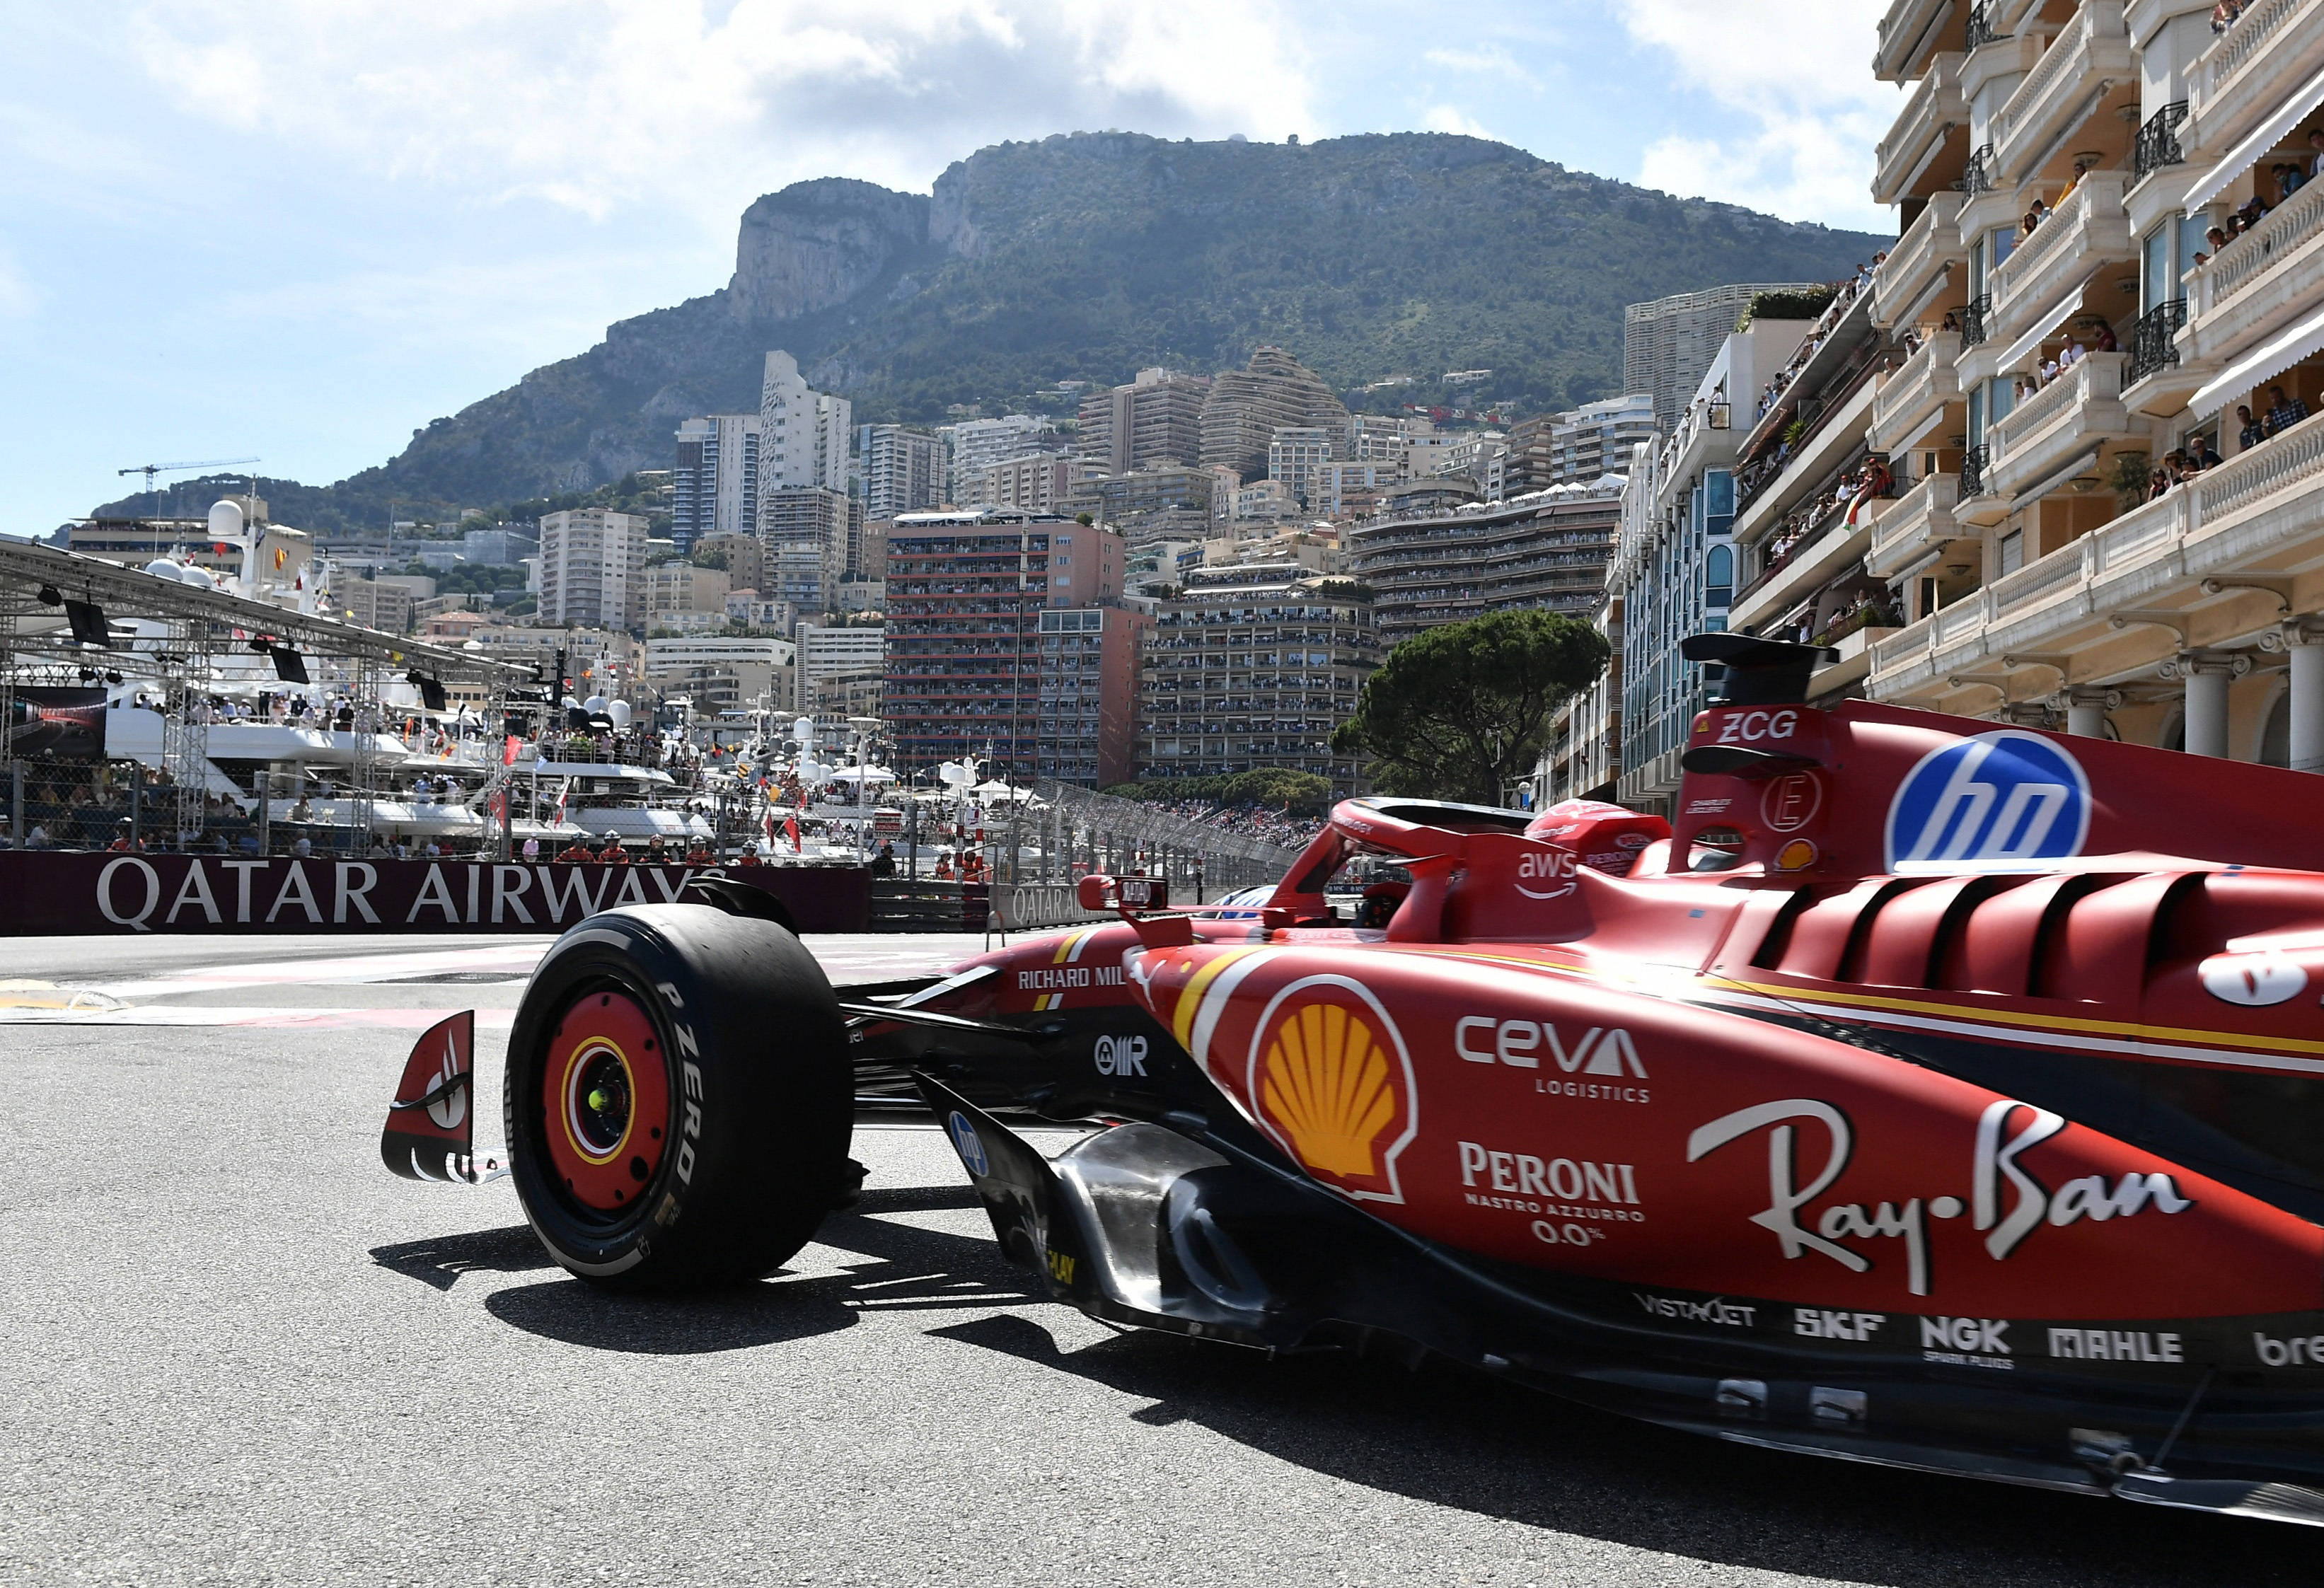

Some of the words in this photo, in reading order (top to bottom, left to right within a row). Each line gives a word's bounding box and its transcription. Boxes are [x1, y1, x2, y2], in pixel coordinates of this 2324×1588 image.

[1774, 775, 1807, 826] E
[1908, 738, 2070, 860] hp
[1518, 852, 1578, 879] aws
[96, 857, 383, 931] QATAR
[1012, 888, 1063, 925] QATAR
[1019, 968, 1090, 989] RICHARD
[655, 982, 685, 1009] P
[675, 1026, 703, 1187] ZERO
[1536, 1079, 1650, 1103] LOGISTICS
[1458, 1140, 1641, 1205] PERONI
[1465, 1193, 1542, 1215] NASTRO
[1547, 1203, 1645, 1222] AZZURRO
[1532, 1219, 1607, 1247] 0.0%
[1793, 1307, 1886, 1341] SKF
[1919, 1315, 2013, 1354] NGK
[2046, 1327, 2185, 1363] MAHLE
